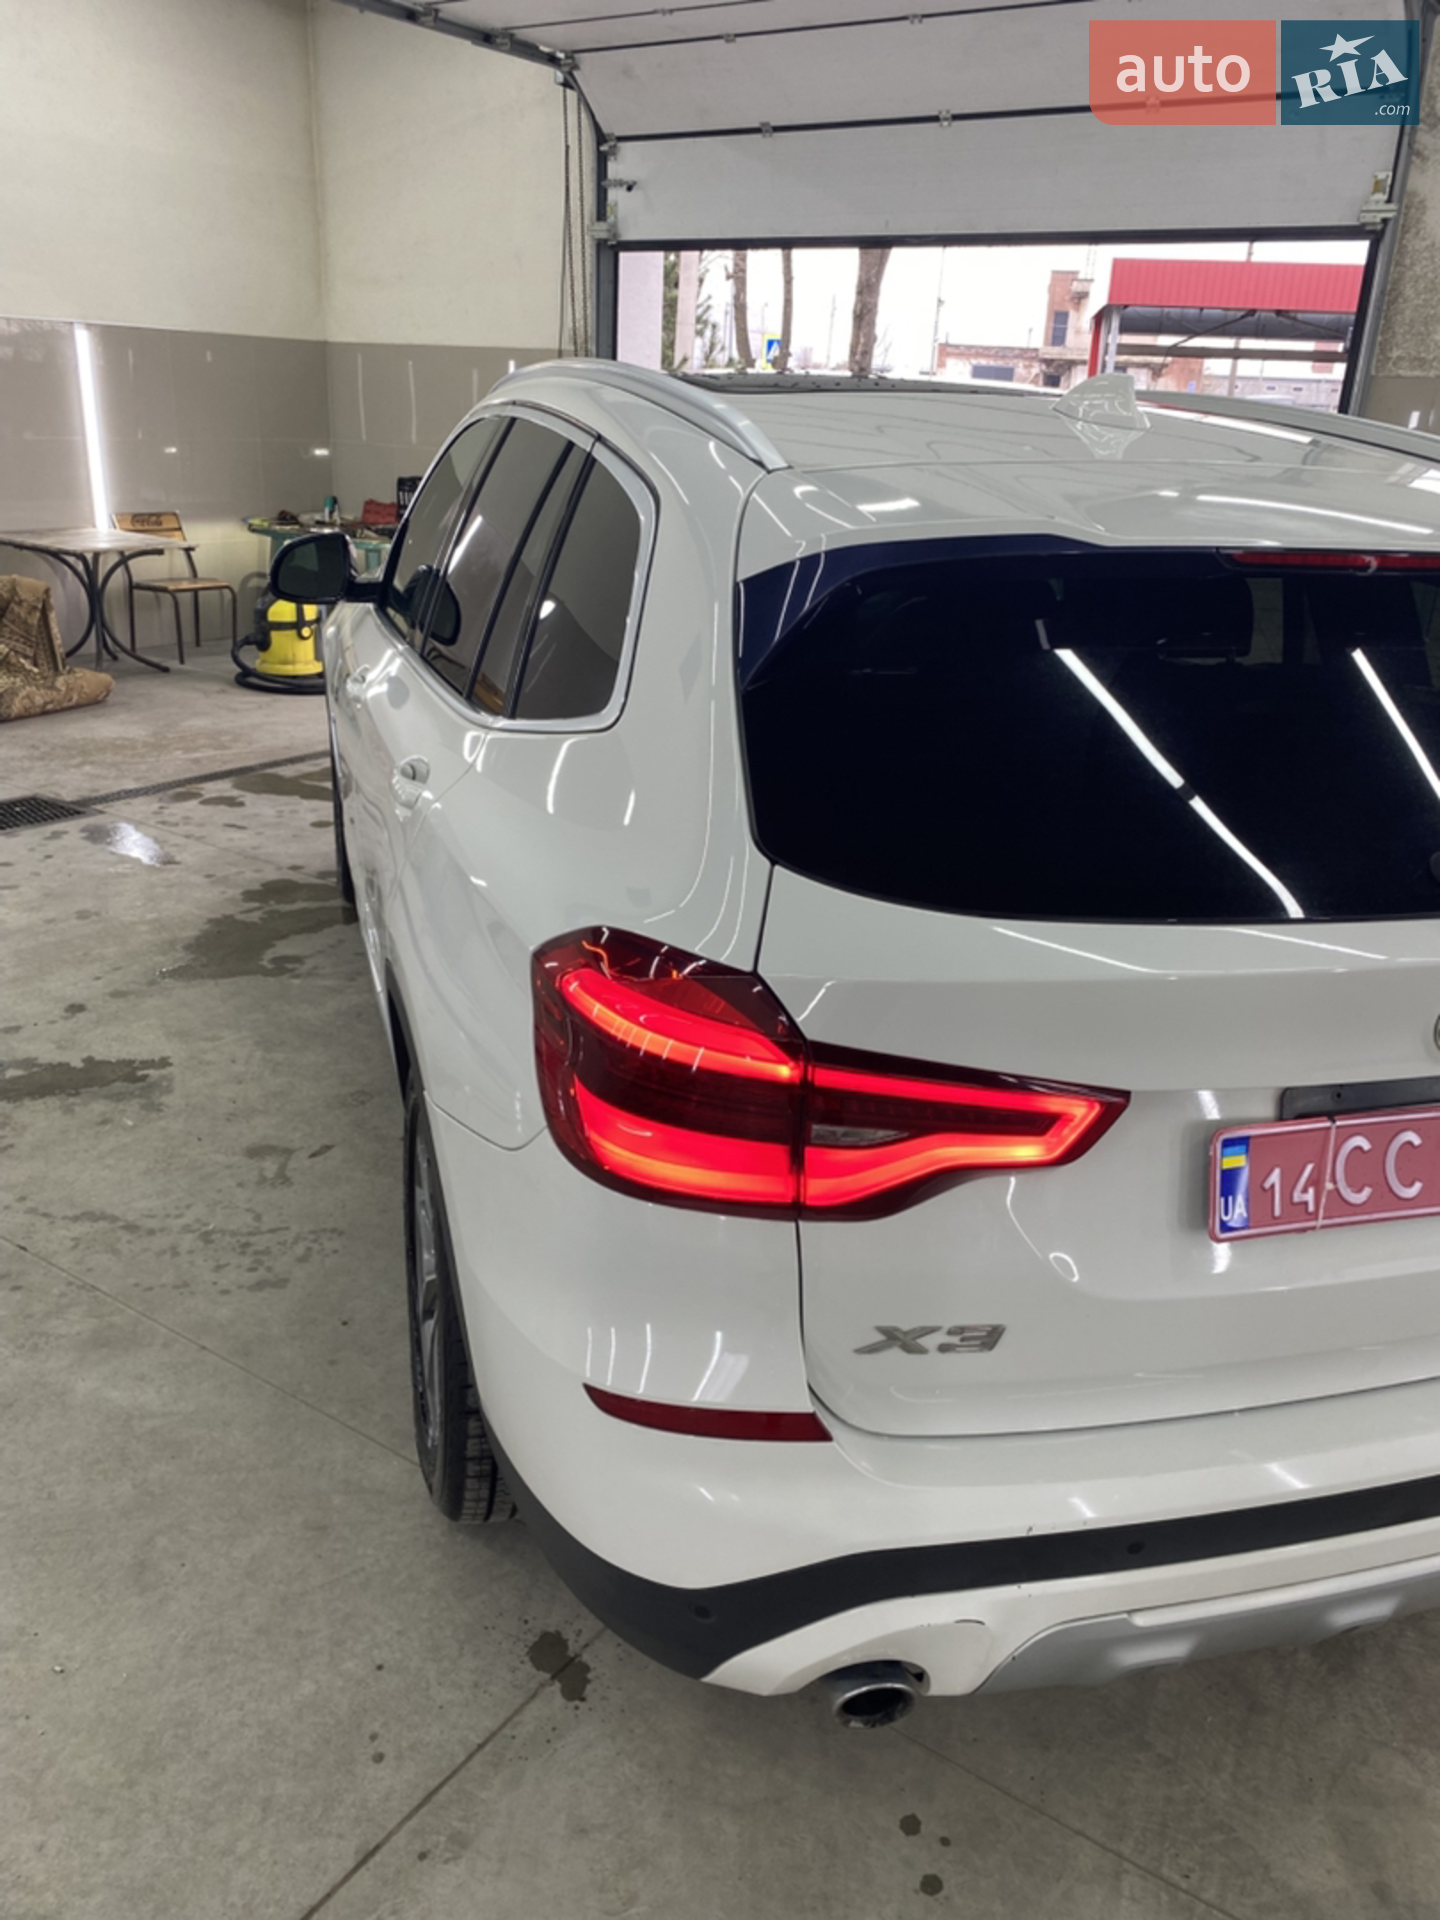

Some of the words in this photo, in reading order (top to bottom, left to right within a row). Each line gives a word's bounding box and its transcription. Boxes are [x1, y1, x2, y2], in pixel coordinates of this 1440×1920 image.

[1262, 1162, 1316, 1218] 14
[1335, 1129, 1424, 1206] CC
[1219, 1195, 1248, 1221] UA
[852, 1324, 1007, 1355] X3
